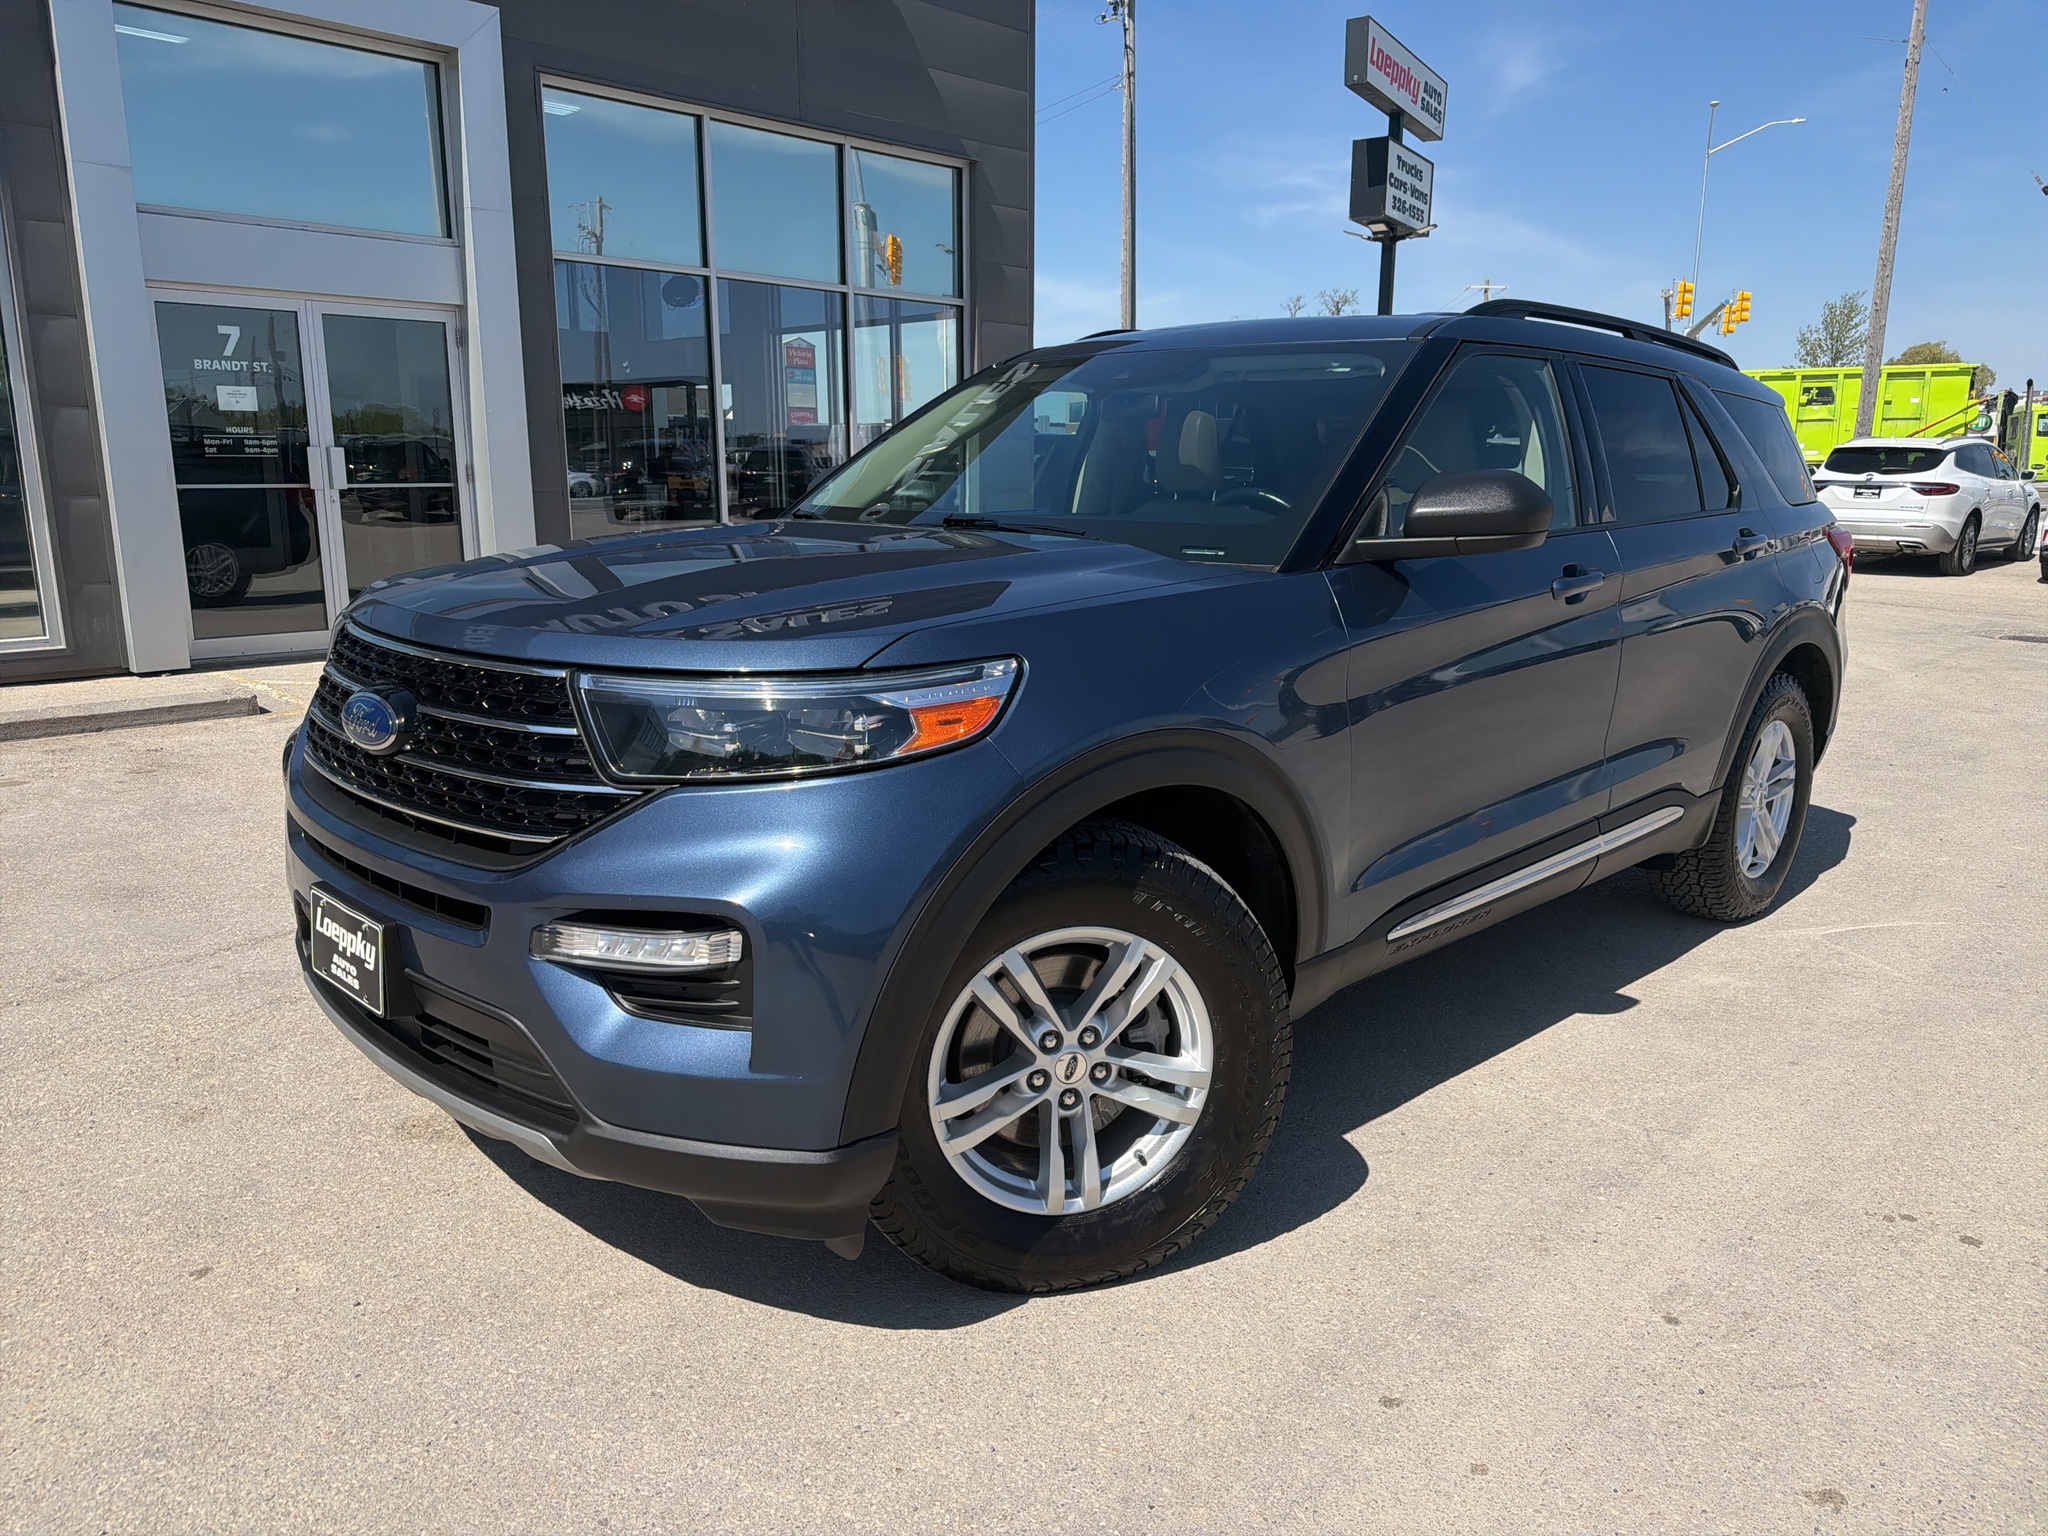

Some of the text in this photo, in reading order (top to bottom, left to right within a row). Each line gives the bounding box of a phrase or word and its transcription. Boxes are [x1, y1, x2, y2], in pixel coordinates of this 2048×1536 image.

[1369, 36, 1421, 106] Loeppky
[1423, 80, 1442, 107] AUTO
[1420, 96, 1442, 125] SALES
[1396, 154, 1424, 183] Trucks
[217, 325, 241, 357] 7
[193, 358, 272, 373] BRANDT ST.
[203, 438, 233, 446] Mon-Fri
[225, 426, 254, 434] HOURS
[350, 703, 380, 739] Ford
[315, 906, 377, 972] Loeppky
[330, 964, 360, 991] SALES
[332, 953, 358, 977] AUTO
